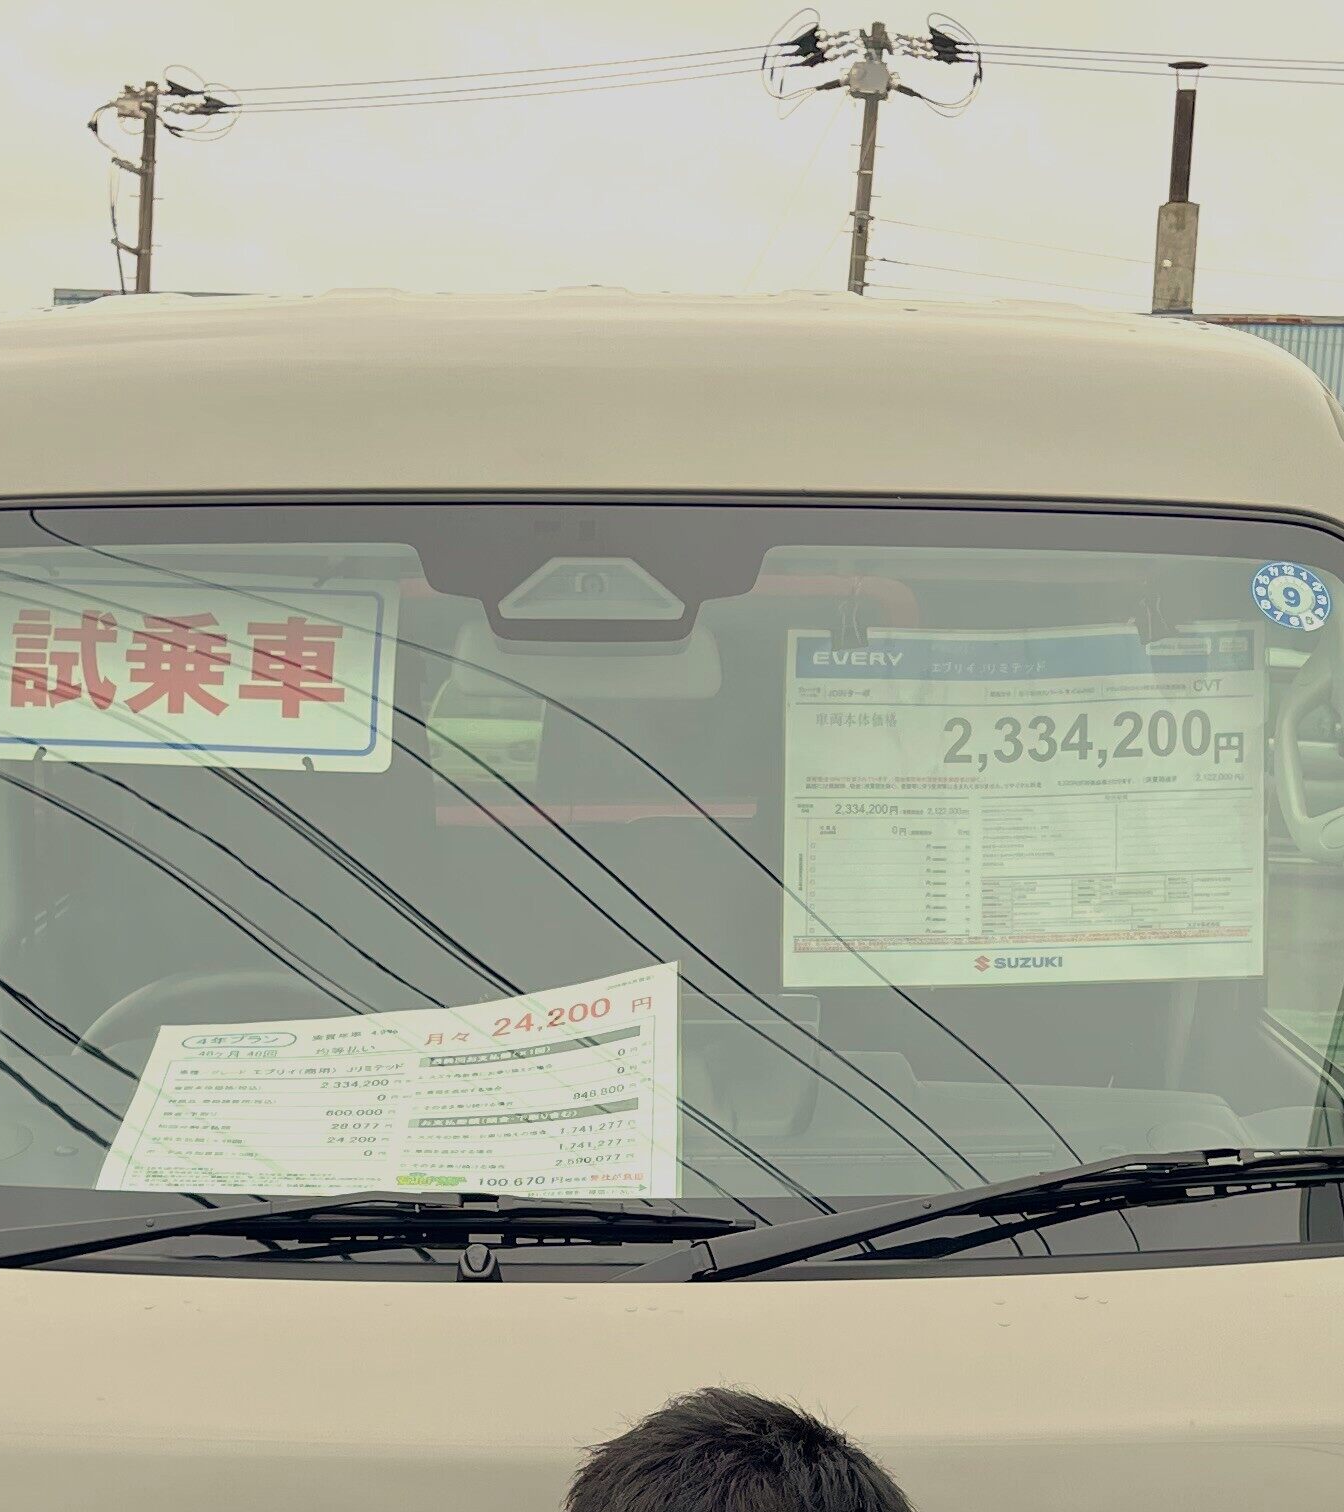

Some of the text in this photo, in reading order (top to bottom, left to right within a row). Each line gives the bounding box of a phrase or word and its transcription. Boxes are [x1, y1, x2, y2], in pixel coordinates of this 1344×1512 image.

[1282, 586, 1301, 608] 9
[10, 610, 345, 719] 試乗車
[812, 651, 904, 667] EVERY
[1192, 678, 1223, 692] CVT
[816, 712, 898, 729] 車両本体価格
[943, 708, 1244, 773] 2,334,200円
[993, 956, 1063, 970] SUZUKI
[424, 996, 653, 1046] 月々 24,200 円
[320, 1079, 389, 1089] 2334,200
[326, 1108, 384, 1117] 600000
[331, 1122, 380, 1130] 28077
[327, 1135, 377, 1144] 24200
